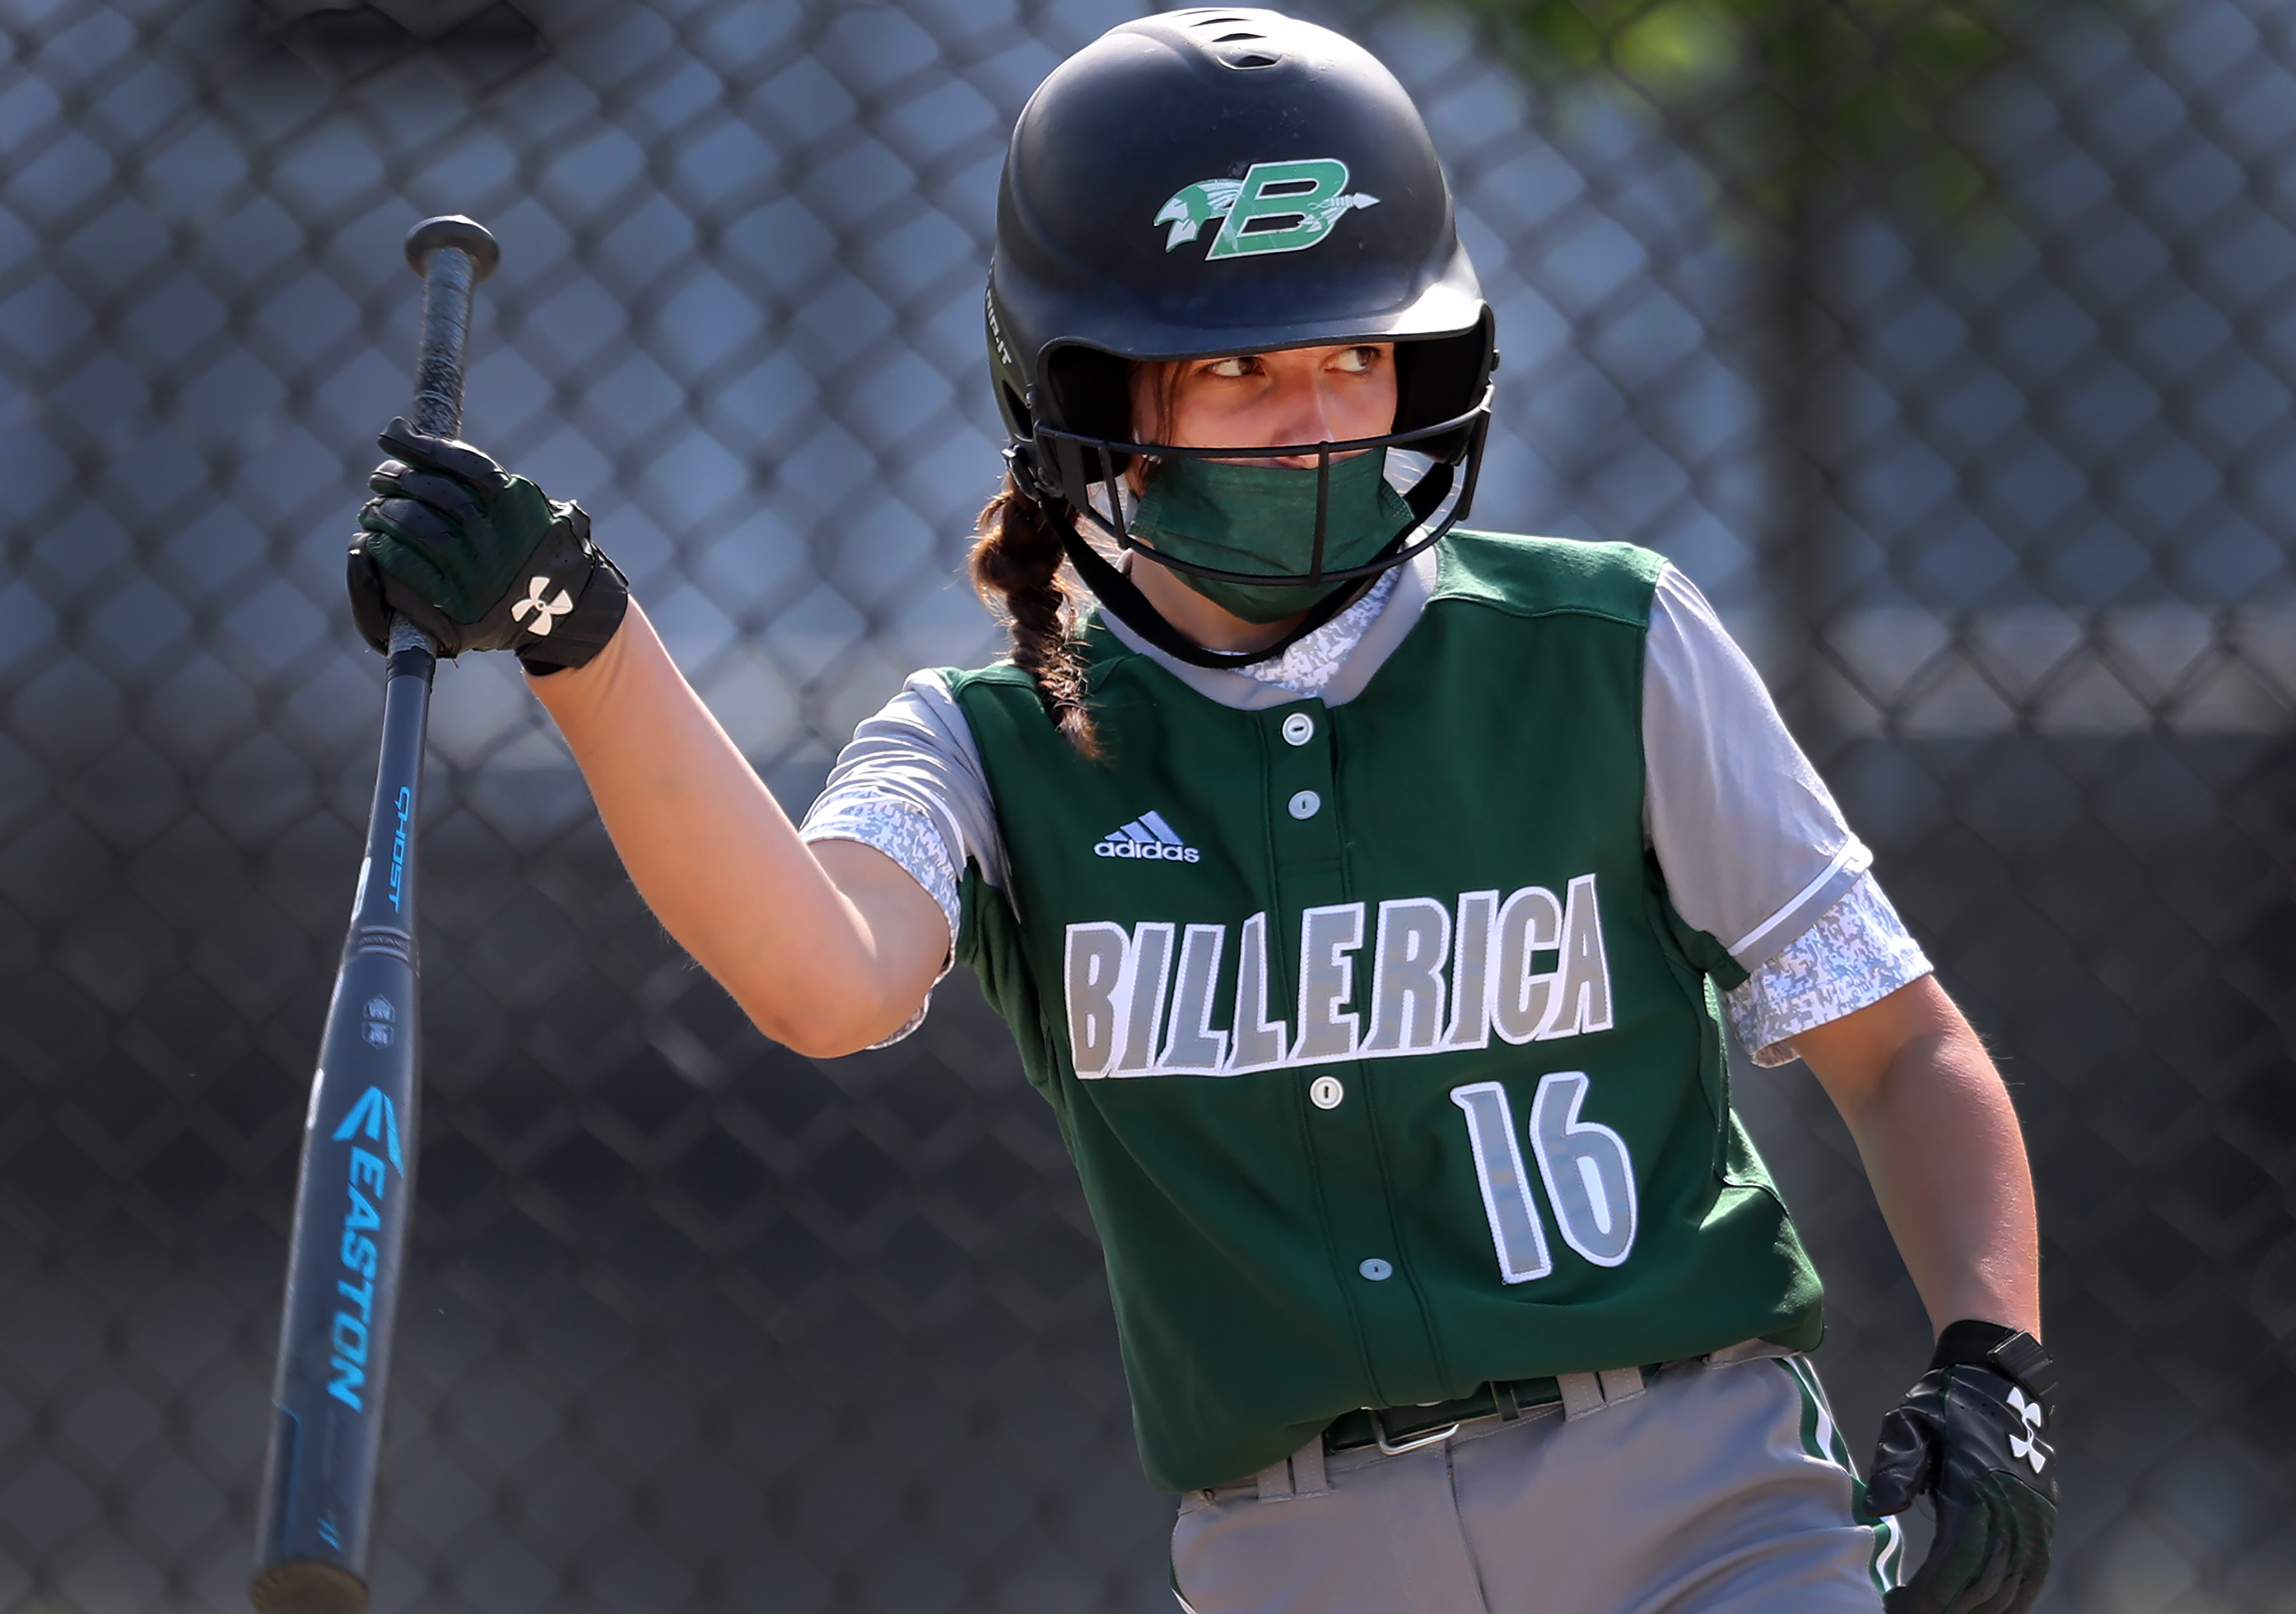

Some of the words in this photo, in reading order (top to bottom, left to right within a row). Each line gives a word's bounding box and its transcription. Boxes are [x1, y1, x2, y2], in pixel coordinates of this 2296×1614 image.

[1205, 158, 1349, 261] B
[388, 785, 411, 913] GHOST
[1094, 840, 1200, 863] adidas
[1064, 873, 1614, 1079] BILLERICA
[1450, 1071, 1637, 1284] 16
[327, 1145, 385, 1412] EASTON
